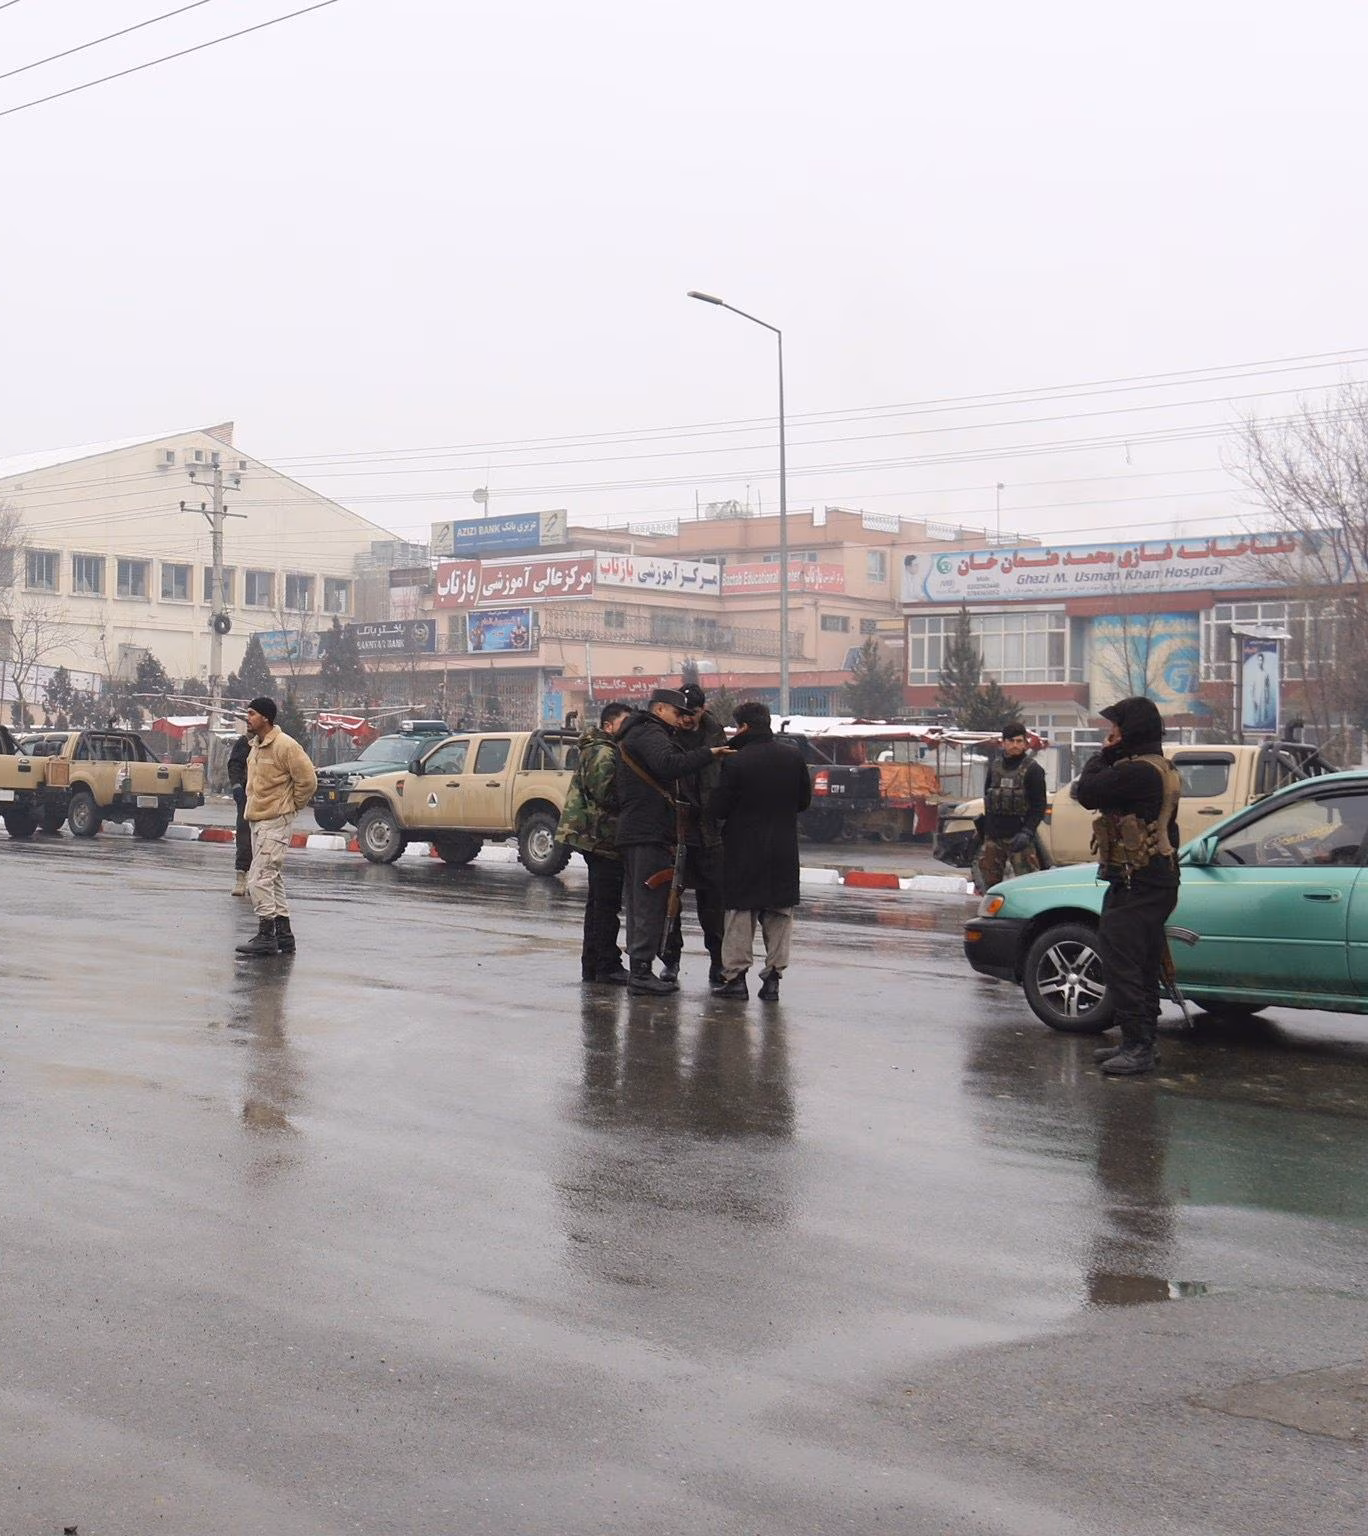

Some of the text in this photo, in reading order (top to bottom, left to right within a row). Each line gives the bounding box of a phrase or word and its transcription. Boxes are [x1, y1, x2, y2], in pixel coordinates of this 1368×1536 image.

[456, 524, 501, 538] AZIZI BANK
[957, 552, 999, 577] خان
[1062, 550, 1115, 566] محمد
[437, 565, 592, 603] مرکز عالی آموزشی بازتاب
[599, 556, 718, 590] مرکز آموزشی بازتاب
[1016, 564, 1225, 585] Ghazi M. Usman Khan Hospital
